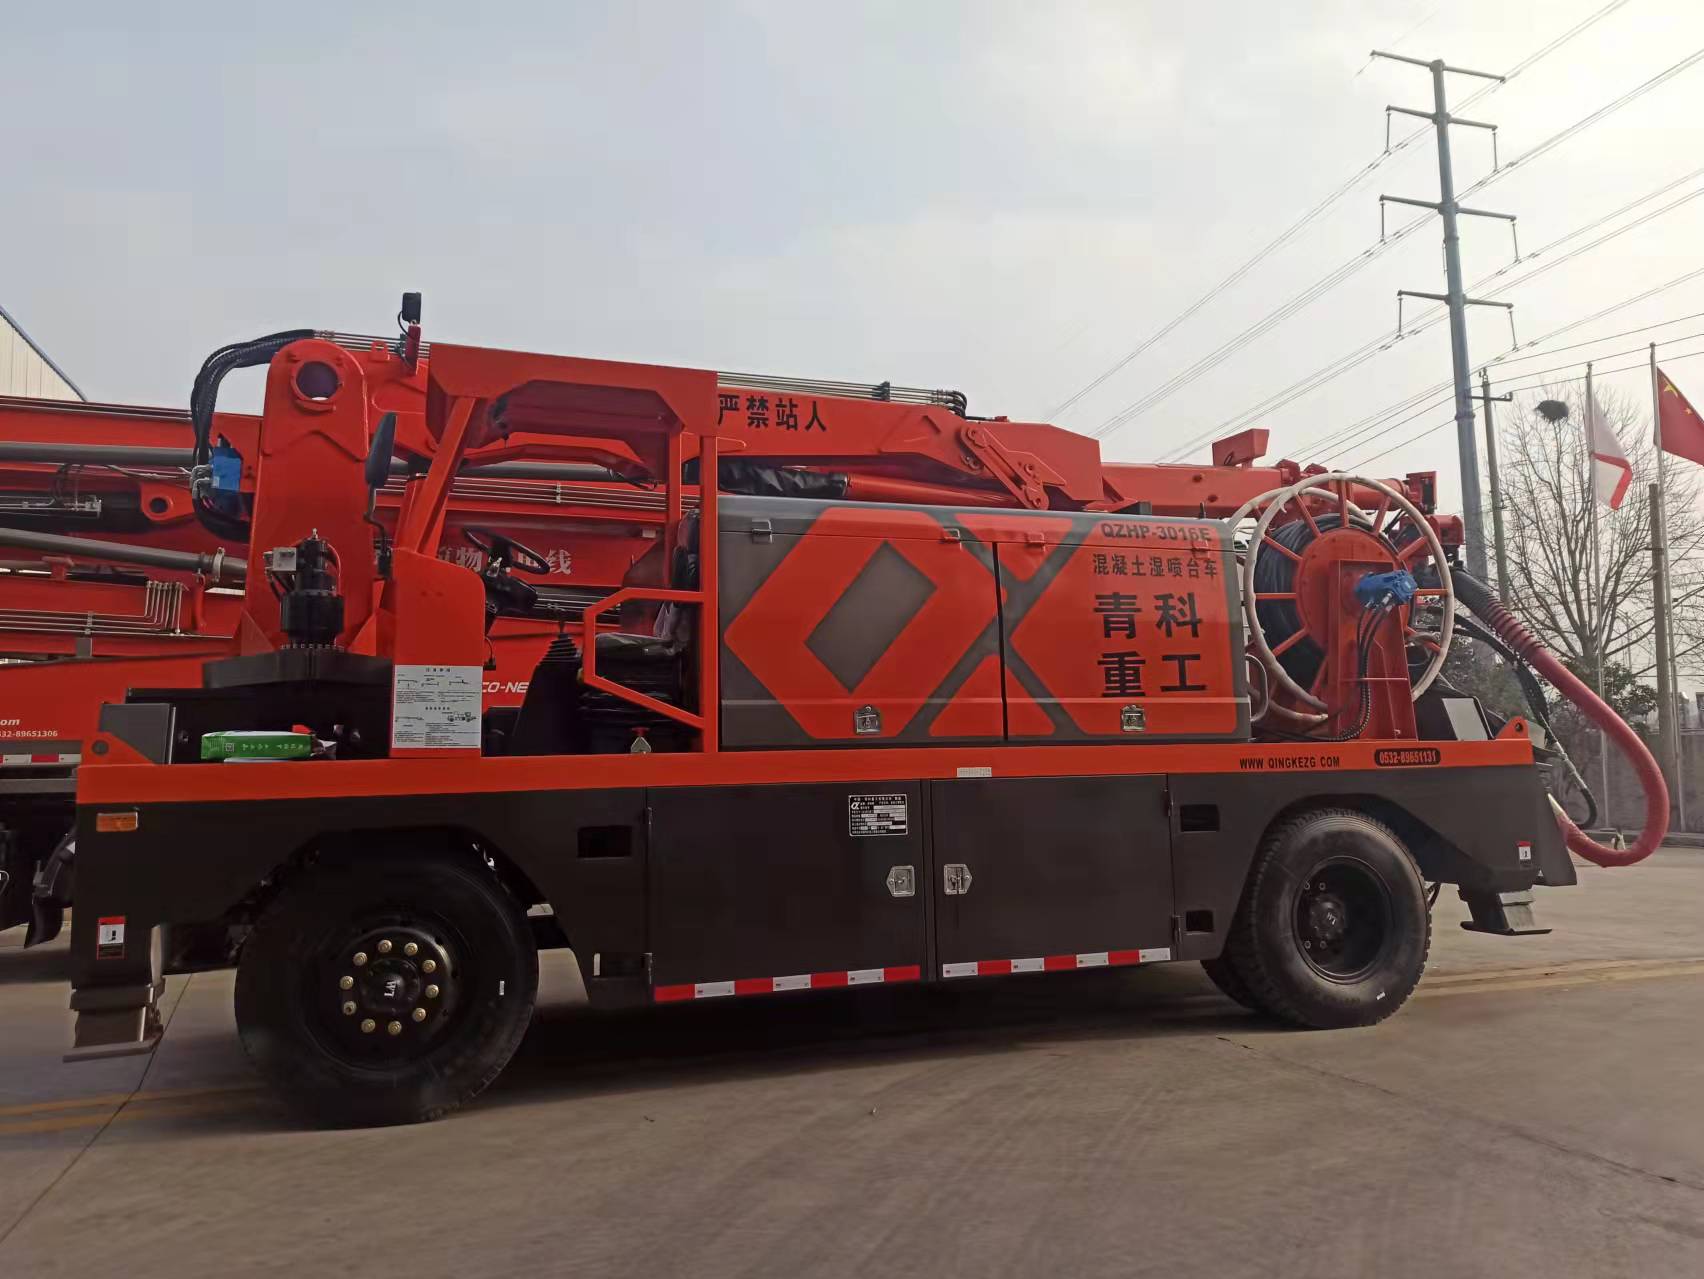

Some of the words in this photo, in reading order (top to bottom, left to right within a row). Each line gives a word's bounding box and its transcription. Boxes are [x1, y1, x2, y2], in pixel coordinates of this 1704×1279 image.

[717, 393, 827, 432] 严禁站人
[1101, 523, 1212, 541] QZHP-3016E
[1093, 552, 1218, 579] 混凝土湿喷台车
[1093, 592, 1203, 639] 青科
[1097, 651, 1207, 697] 重工
[0, 730, 58, 738] 32-89651306
